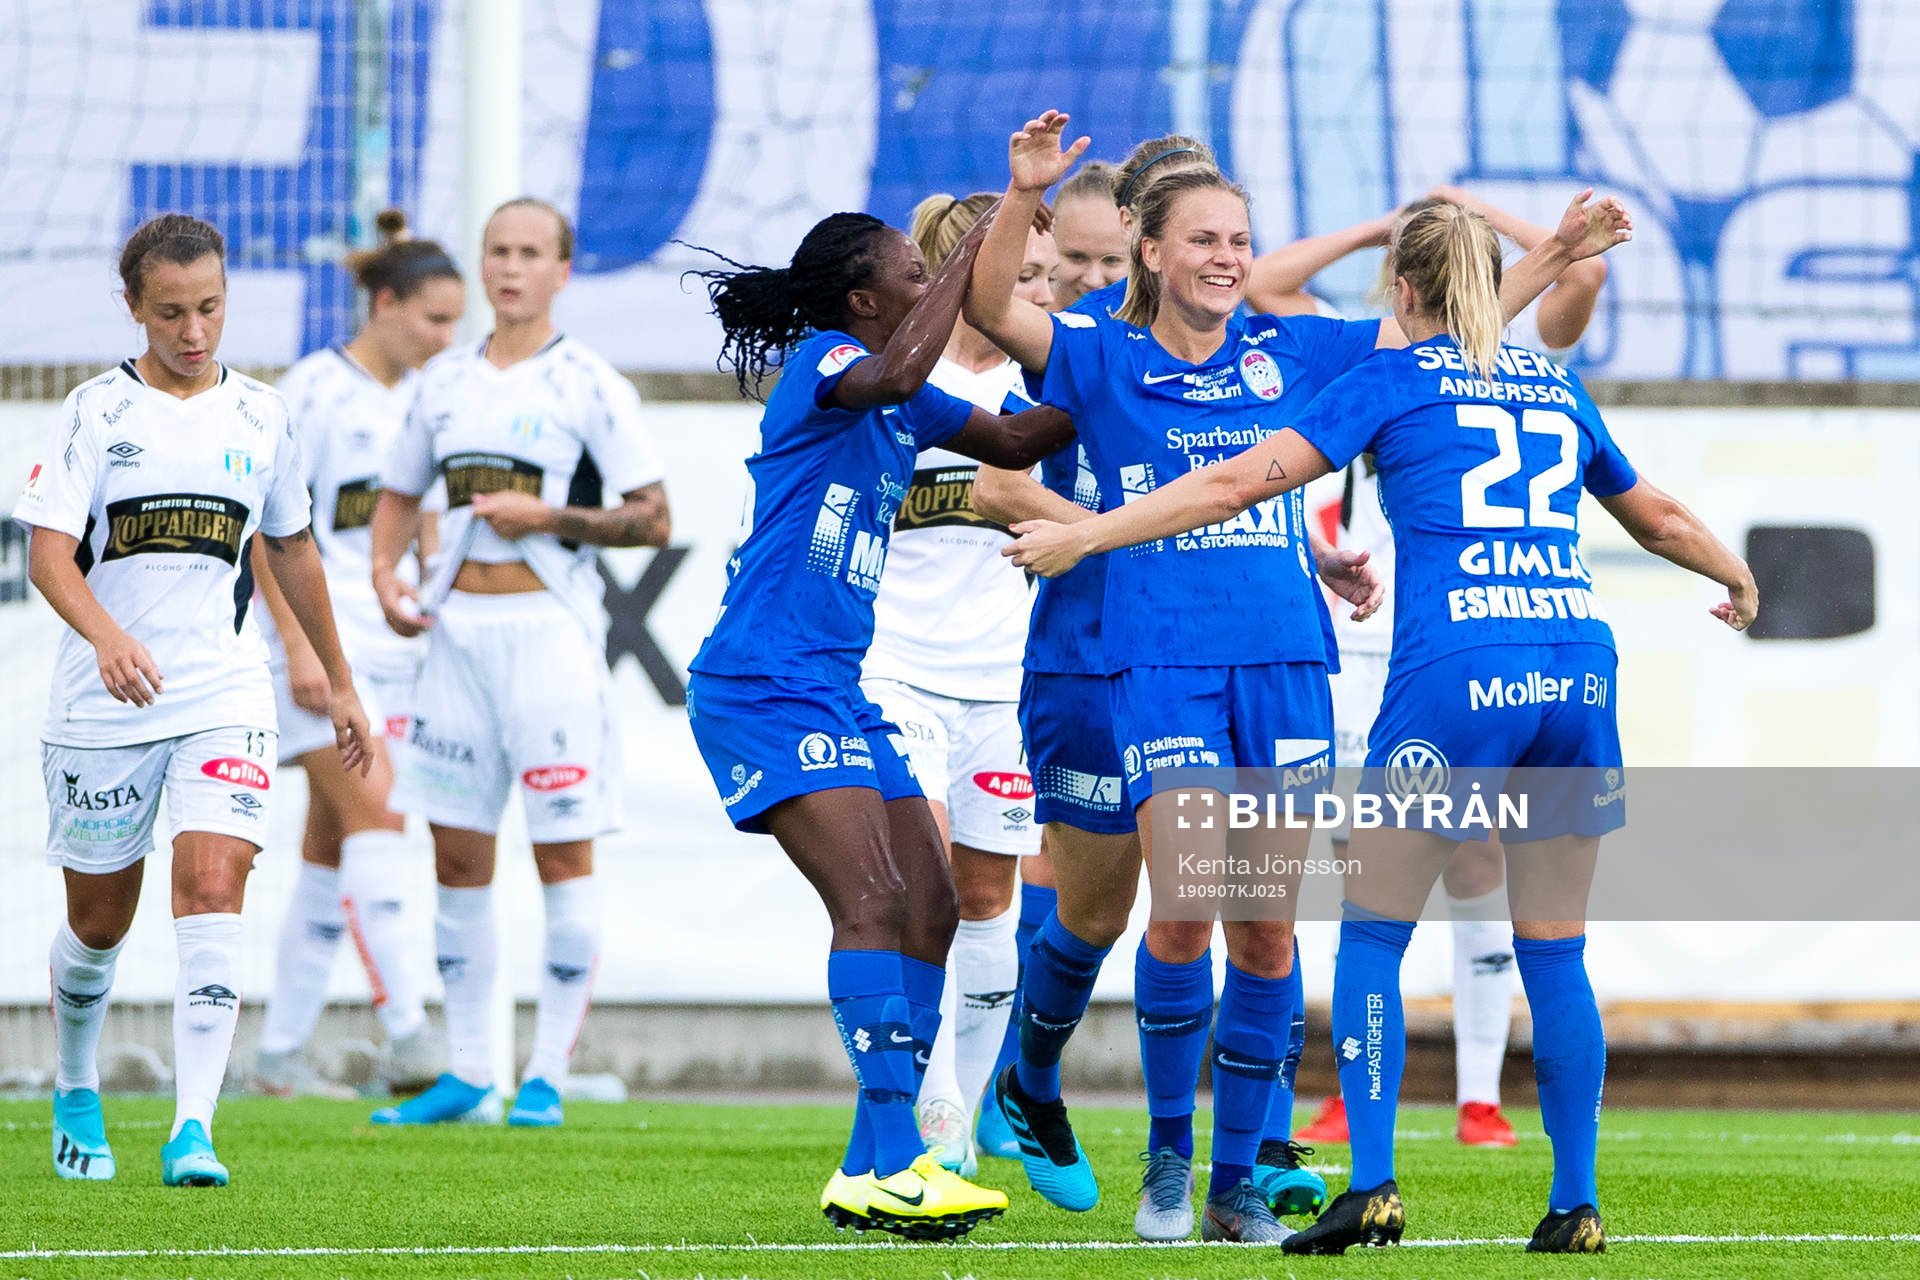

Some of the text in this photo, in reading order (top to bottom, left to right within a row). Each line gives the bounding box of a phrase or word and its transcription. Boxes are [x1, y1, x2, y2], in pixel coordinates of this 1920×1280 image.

[110, 460, 141, 468] umbro
[1455, 404, 1579, 530] 22
[141, 498, 226, 513] PREMIUM CIDER
[1176, 534, 1200, 552] ICA
[1583, 672, 1608, 709] Bil
[1143, 736, 1205, 755] Eskilstuna
[1188, 750, 1199, 764] &
[66, 784, 143, 811] RASTA
[1038, 792, 1122, 813] KOMMUNFASTIGHET
